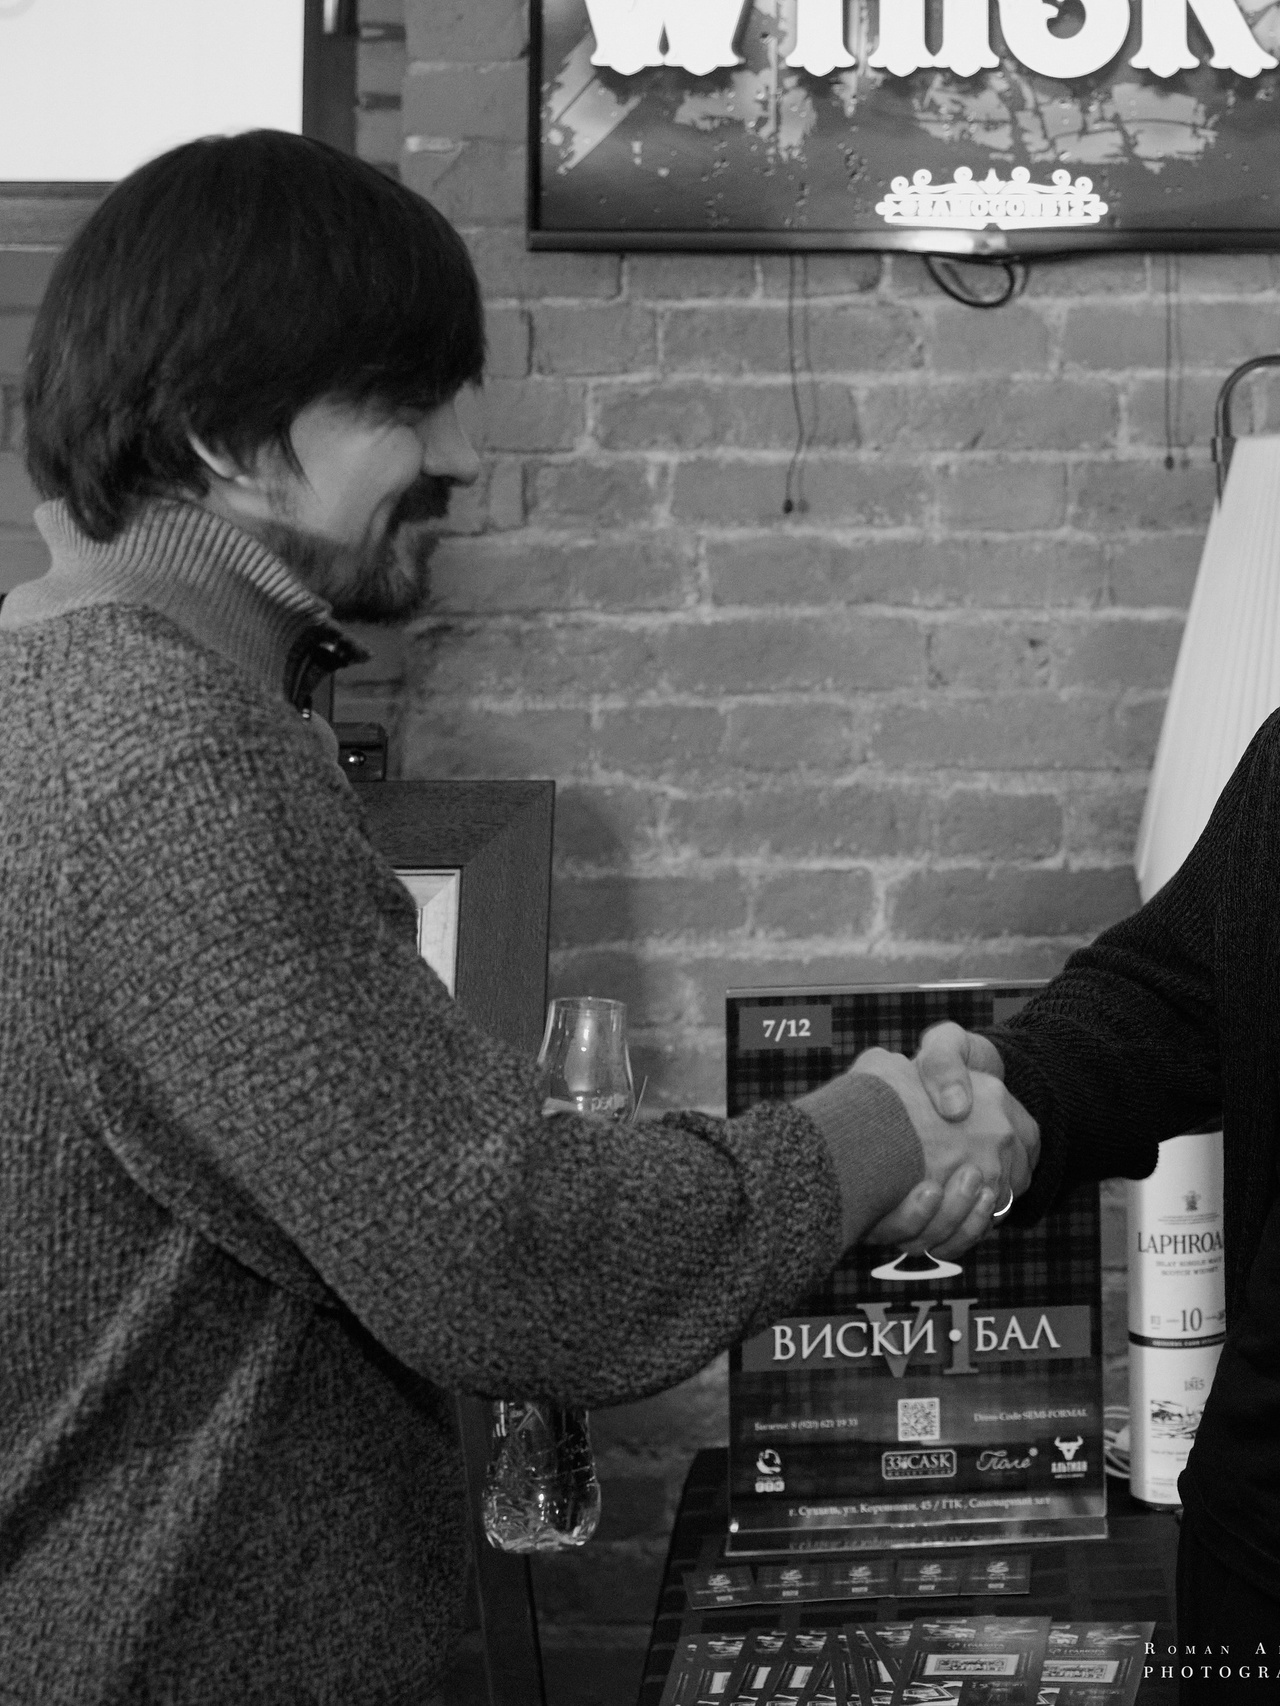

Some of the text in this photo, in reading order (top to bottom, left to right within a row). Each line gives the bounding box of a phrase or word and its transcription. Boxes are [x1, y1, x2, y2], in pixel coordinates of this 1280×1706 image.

[762, 1018, 811, 1042] 7/12
[1137, 1231, 1223, 1255] LAPHROA
[1182, 1307, 1202, 1332] 10
[771, 1314, 1062, 1361] ВИСКИ БАЛ
[907, 1453, 951, 1470] CASK
